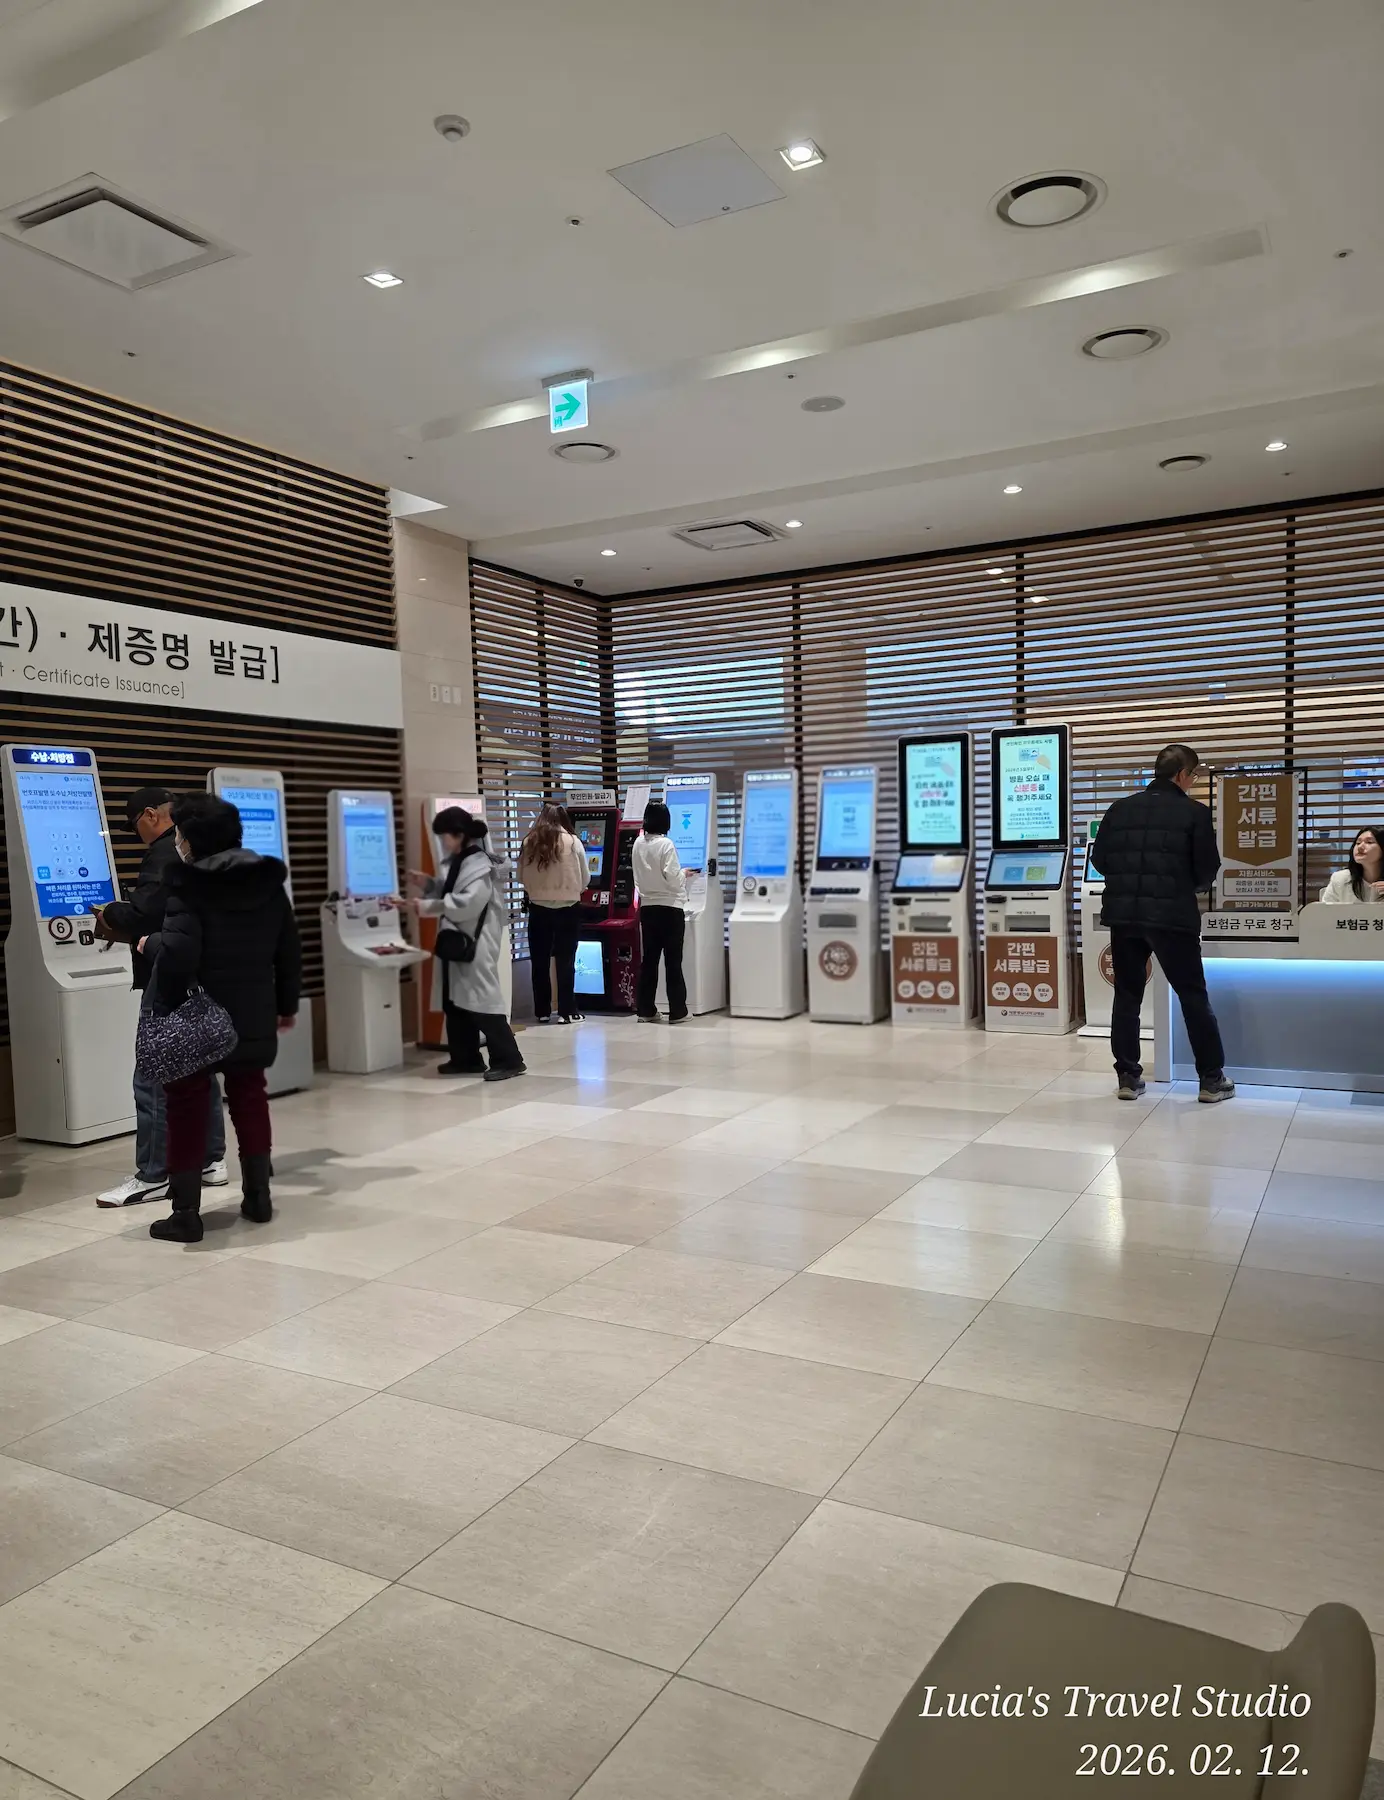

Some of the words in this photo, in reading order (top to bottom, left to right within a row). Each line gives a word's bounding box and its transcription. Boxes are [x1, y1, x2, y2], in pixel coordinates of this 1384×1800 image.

[88, 622, 189, 671] 제증명
[210, 639, 279, 684] 발급]
[23, 665, 110, 690] Certificate
[116, 675, 185, 699] Issuance]
[1238, 783, 1277, 802] 간편
[1238, 807, 1277, 824] 서류
[1238, 830, 1277, 848] 발급
[56, 922, 66, 934] 6
[1207, 919, 1241, 930] 보험금
[1244, 919, 1267, 930] 무료
[1271, 918, 1294, 931] 청구
[1336, 919, 1370, 931] 보험금
[1008, 942, 1035, 957] 간편
[994, 959, 1050, 974] 서류발급
